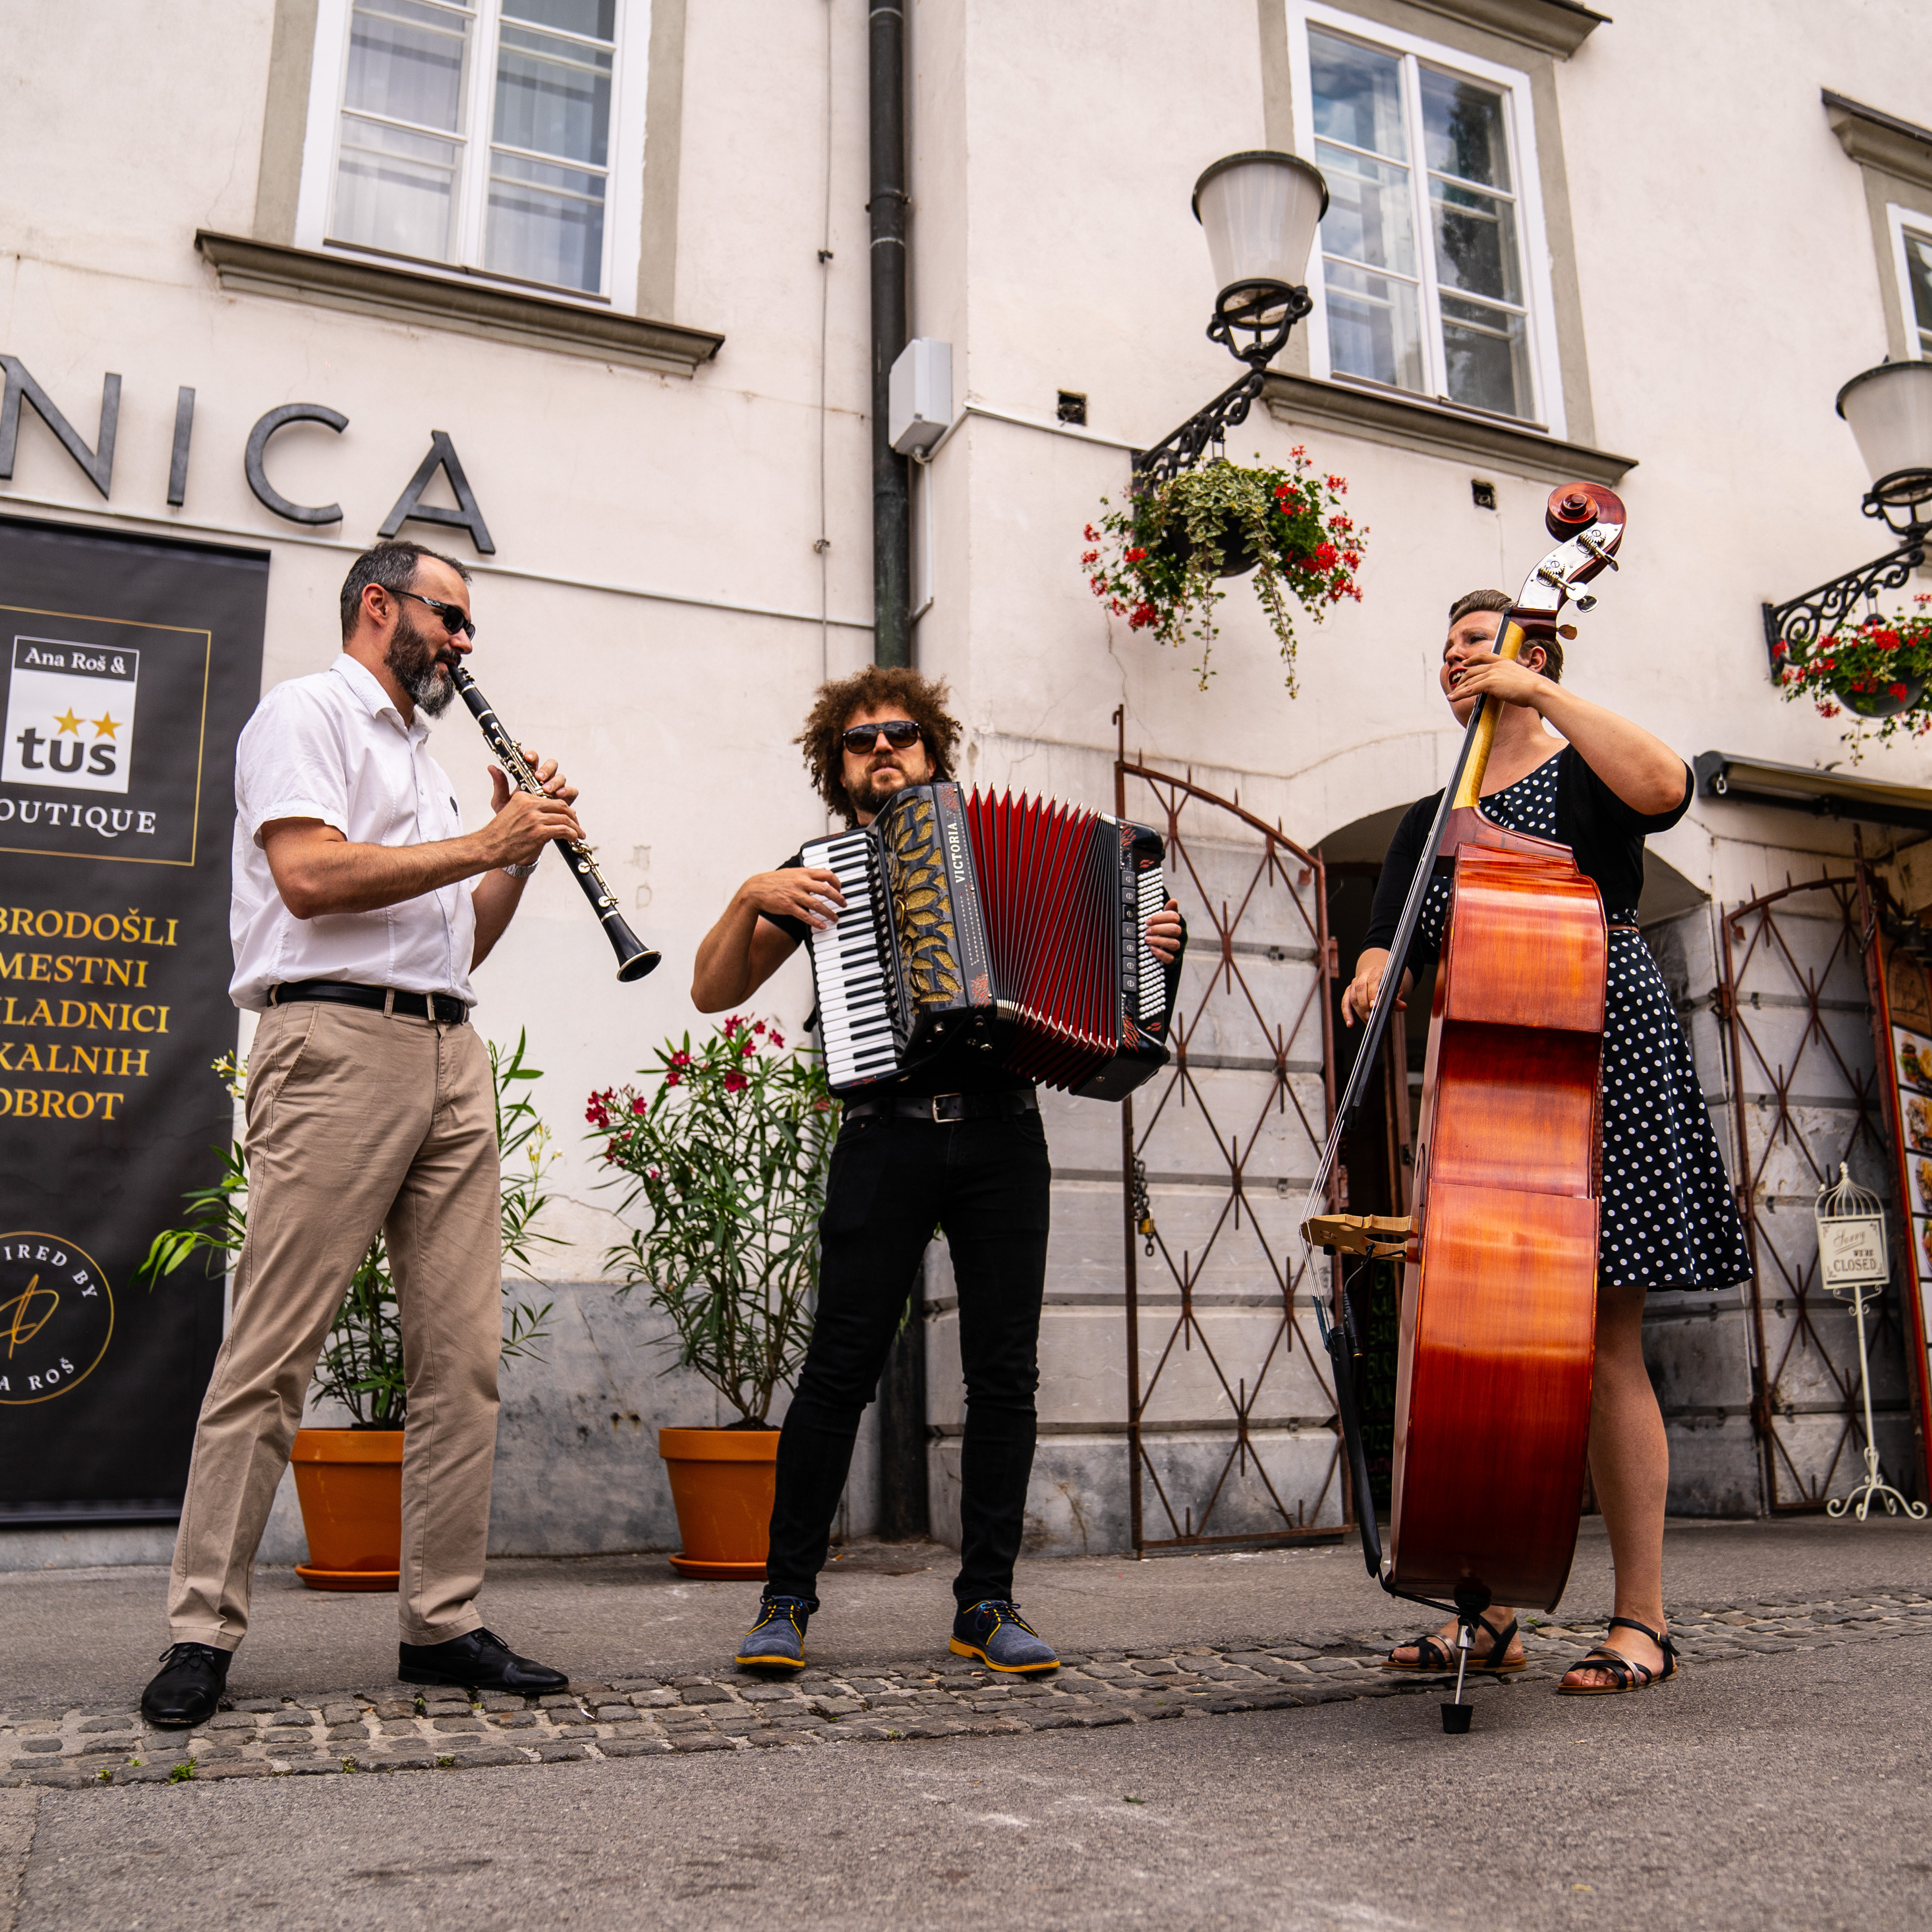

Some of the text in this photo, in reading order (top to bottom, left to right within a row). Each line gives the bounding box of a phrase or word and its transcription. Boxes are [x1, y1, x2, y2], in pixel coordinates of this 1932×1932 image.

[25, 647, 127, 675] Ana Roš &
[947, 823, 965, 883] VICTORIA
[0, 996, 170, 1033] LADNICI
[1833, 1258, 1877, 1272] CLOSED
[72, 1269, 98, 1298] BY
[28, 1357, 74, 1391] ROŠ
